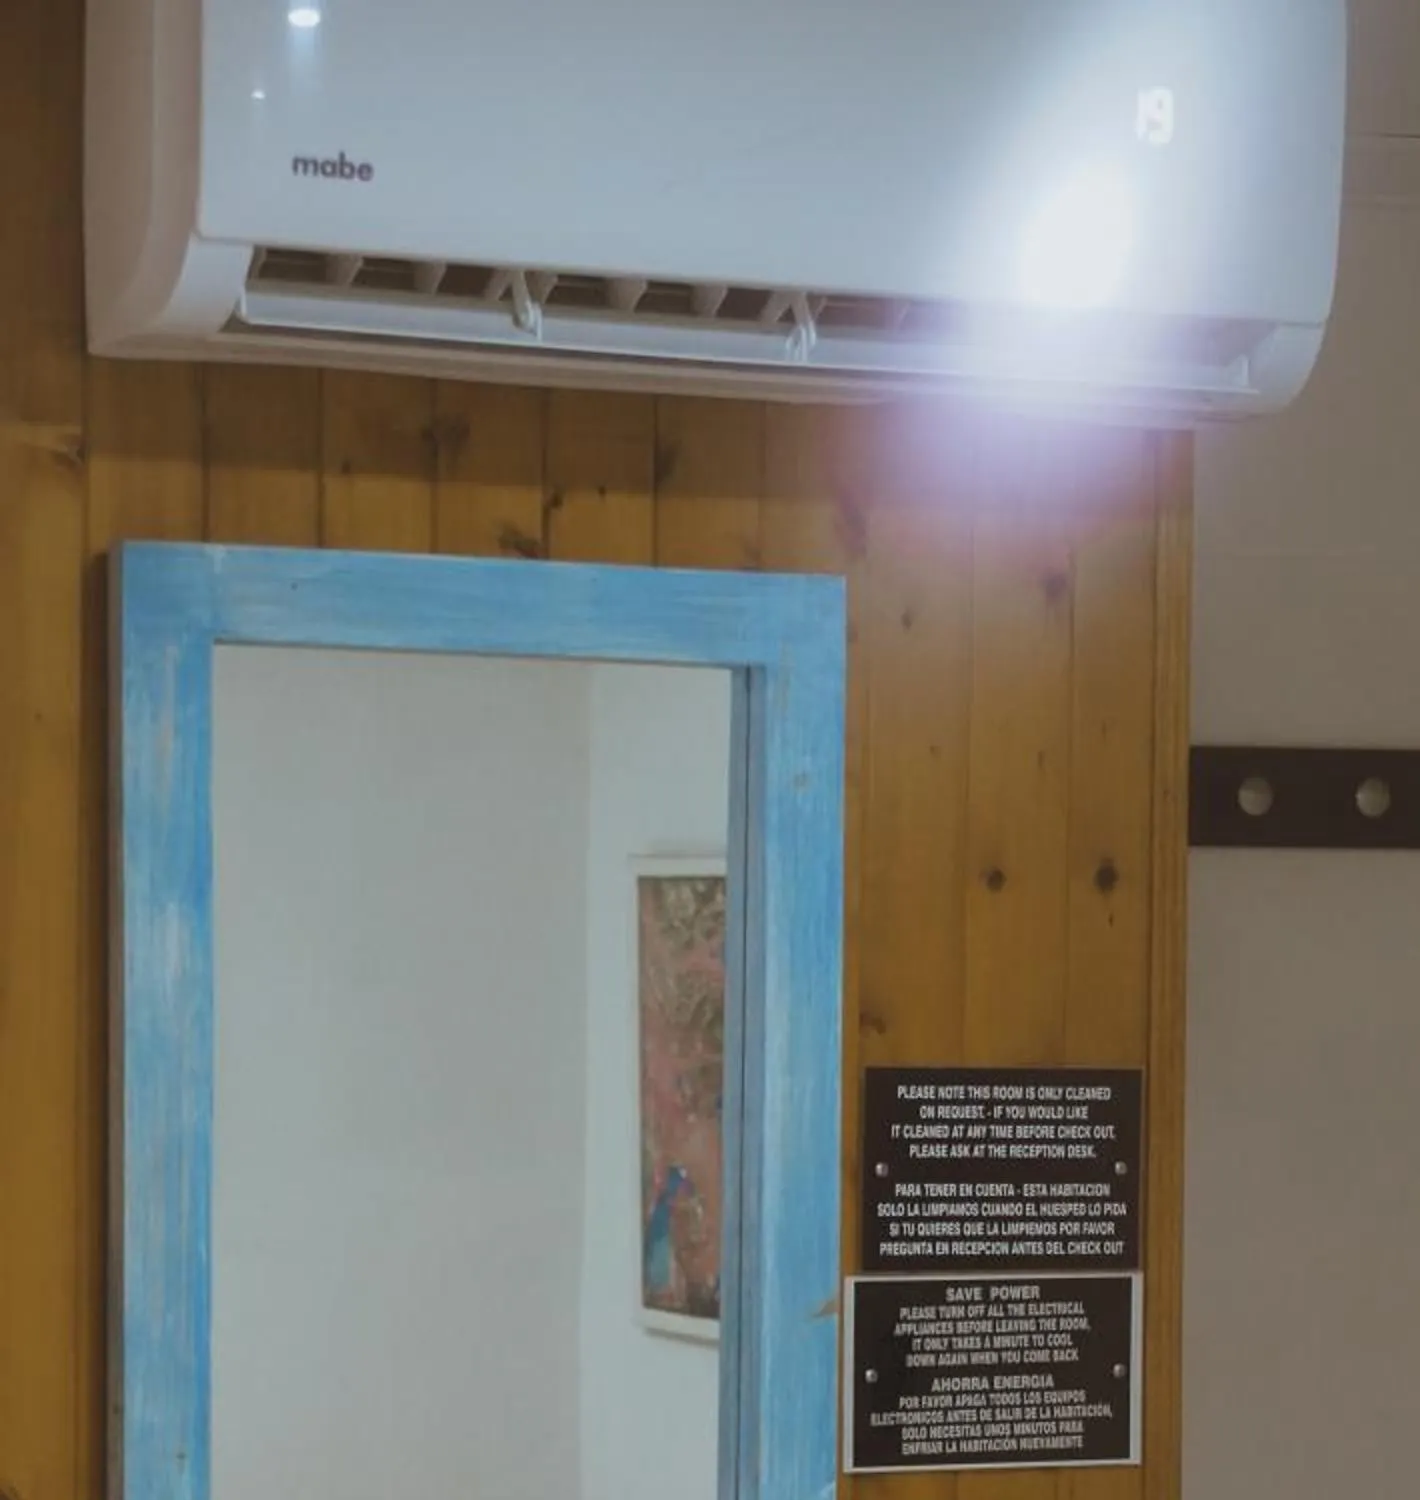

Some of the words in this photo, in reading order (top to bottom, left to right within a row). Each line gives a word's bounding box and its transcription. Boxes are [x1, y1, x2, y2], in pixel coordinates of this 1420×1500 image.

[292, 150, 374, 181] mabe
[897, 1085, 936, 1099] PLEASE
[938, 1085, 965, 1099] NOTE
[968, 1085, 990, 1099] THIS
[992, 1085, 1023, 1100] ROOM
[1025, 1086, 1036, 1100] IS
[1037, 1086, 1063, 1100] ONLY
[1065, 1086, 1112, 1100] CLEANED
[919, 1105, 935, 1119] ON
[993, 1105, 1003, 1119] IF
[1005, 1105, 1026, 1119] YOU
[1028, 1105, 1064, 1119] WOULD
[1066, 1105, 1089, 1119] LIKE
[891, 1124, 901, 1139] IT
[903, 1124, 949, 1139] CLEANED
[951, 1124, 964, 1139] AT
[966, 1124, 986, 1139] ANY
[989, 1124, 1013, 1139] TIME
[1015, 1124, 1055, 1139] BEFORE
[1057, 1124, 1091, 1139] CHECK
[909, 1144, 948, 1158] PLEASE
[949, 1144, 970, 1158] ASK
[972, 1144, 985, 1158] AT
[987, 1144, 1008, 1158] THE
[1009, 1144, 1065, 1158] RECEPTION
[895, 1184, 921, 1198] PARA
[924, 1184, 957, 1198] TENER
[959, 1184, 973, 1198] EN
[975, 1183, 1014, 1198] CUENTA
[1023, 1183, 1048, 1197] ESTA
[877, 1203, 905, 1217] SOLO
[907, 1203, 919, 1217] LA
[921, 1203, 979, 1217] LIMPIAMOS
[981, 1203, 1023, 1217] CUANDO
[1025, 1203, 1038, 1217] EL
[1088, 1203, 1101, 1217] LO
[1103, 1203, 1128, 1217] PIDA
[889, 1223, 900, 1236] SI
[902, 1223, 915, 1236] TU
[917, 1223, 961, 1236] QUIERES
[963, 1223, 984, 1236] QUE
[986, 1223, 999, 1236] LA
[1001, 1222, 1057, 1236] LIMPIEMOS
[1059, 1222, 1081, 1235] POR
[1082, 1222, 1115, 1235] FAVOR
[879, 1242, 934, 1256] PREGUNTA
[935, 1242, 950, 1256] EN
[1011, 1241, 1044, 1255] ANTES
[1045, 1241, 1066, 1255] DEL
[1067, 1241, 1101, 1255] CHECK
[1103, 1241, 1124, 1255] OUT
[945, 1286, 983, 1301] SAVE
[989, 1285, 1040, 1300] POWER
[900, 1306, 937, 1320] PLEASE
[938, 1305, 965, 1319] TURN
[967, 1304, 985, 1318] OFF
[987, 1304, 1005, 1317] ALL
[1007, 1303, 1025, 1317] THE
[1027, 1301, 1084, 1316] ELECTRICAL
[894, 1321, 954, 1336] APPLIANCES
[956, 1320, 993, 1334] BEFORE
[995, 1319, 1037, 1333] LEAVING
[1038, 1318, 1057, 1332] THE
[911, 1338, 921, 1351] IT
[923, 1337, 949, 1351] ONLY
[951, 1336, 982, 1350] TAKES
[984, 1336, 991, 1349] A
[993, 1334, 1030, 1348] MINUTE
[1032, 1334, 1045, 1347] TO
[1047, 1333, 1073, 1347] COOL
[906, 1353, 936, 1367] DOWN
[938, 1351, 968, 1366] AGAIN
[969, 1350, 999, 1364] WHEN
[1001, 1349, 1021, 1363] YOU
[1023, 1348, 1051, 1362] COME
[1053, 1347, 1079, 1361] BACK
[931, 1376, 990, 1392] AHORRA
[993, 1374, 1055, 1390] ENERGIA
[899, 1395, 920, 1409] POR
[921, 1394, 953, 1408] FAVOR
[954, 1393, 987, 1407] APAGA
[989, 1392, 1021, 1406] TODOS
[1022, 1391, 1042, 1405] LOS
[1043, 1390, 1086, 1404] EQUIPOS
[946, 1408, 978, 1424] ANTES
[979, 1408, 993, 1422] DE
[994, 1407, 1022, 1422] SALIR
[1024, 1406, 1038, 1421] DE
[1040, 1406, 1052, 1420] LA
[901, 1426, 928, 1440] SOLO
[929, 1424, 982, 1439] NECESITAS
[984, 1423, 1011, 1437] UNOS
[1013, 1422, 1057, 1436] MINUTOS
[1059, 1421, 1084, 1435] PARA
[945, 1440, 958, 1454] LA
[1020, 1435, 1083, 1451] NUEVAMENTE
